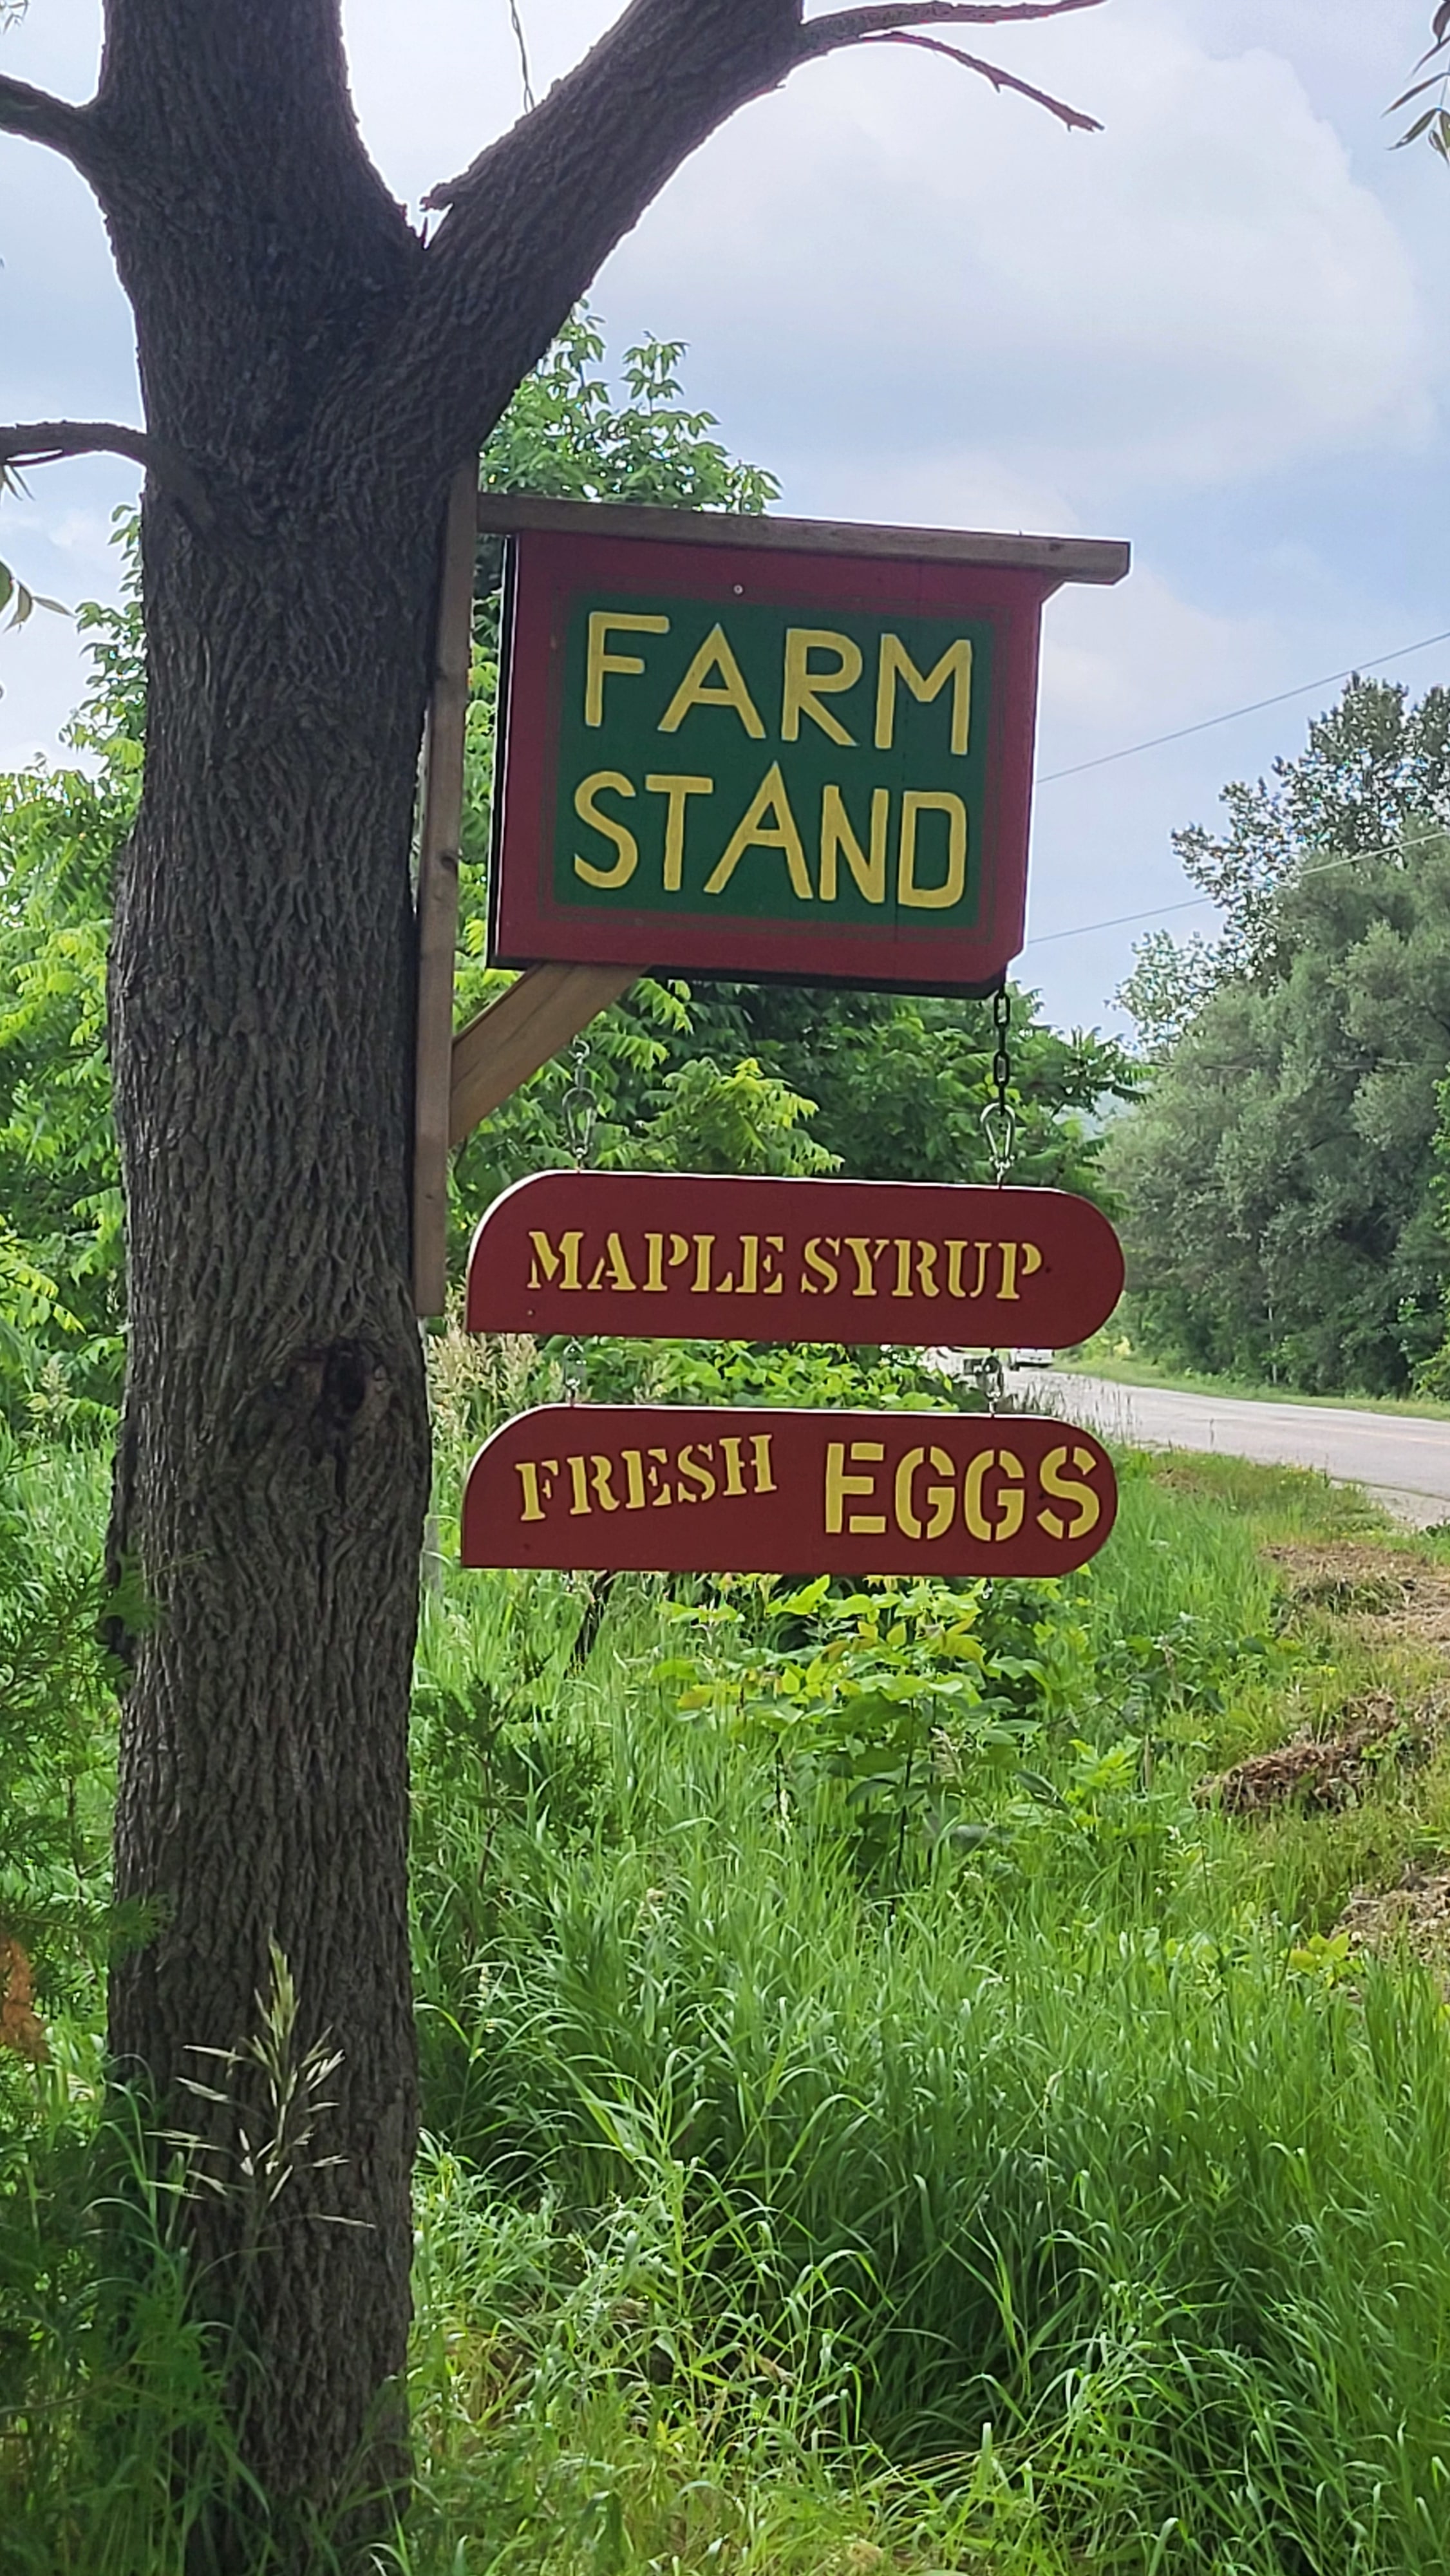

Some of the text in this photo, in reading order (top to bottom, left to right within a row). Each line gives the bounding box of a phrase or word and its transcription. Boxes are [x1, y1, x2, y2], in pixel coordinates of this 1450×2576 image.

[584, 611, 973, 756] FARM
[574, 761, 966, 908] STAND
[527, 1231, 1043, 1301] MAPLE SYRUP
[515, 1434, 1100, 1542] FRESH EGGS
